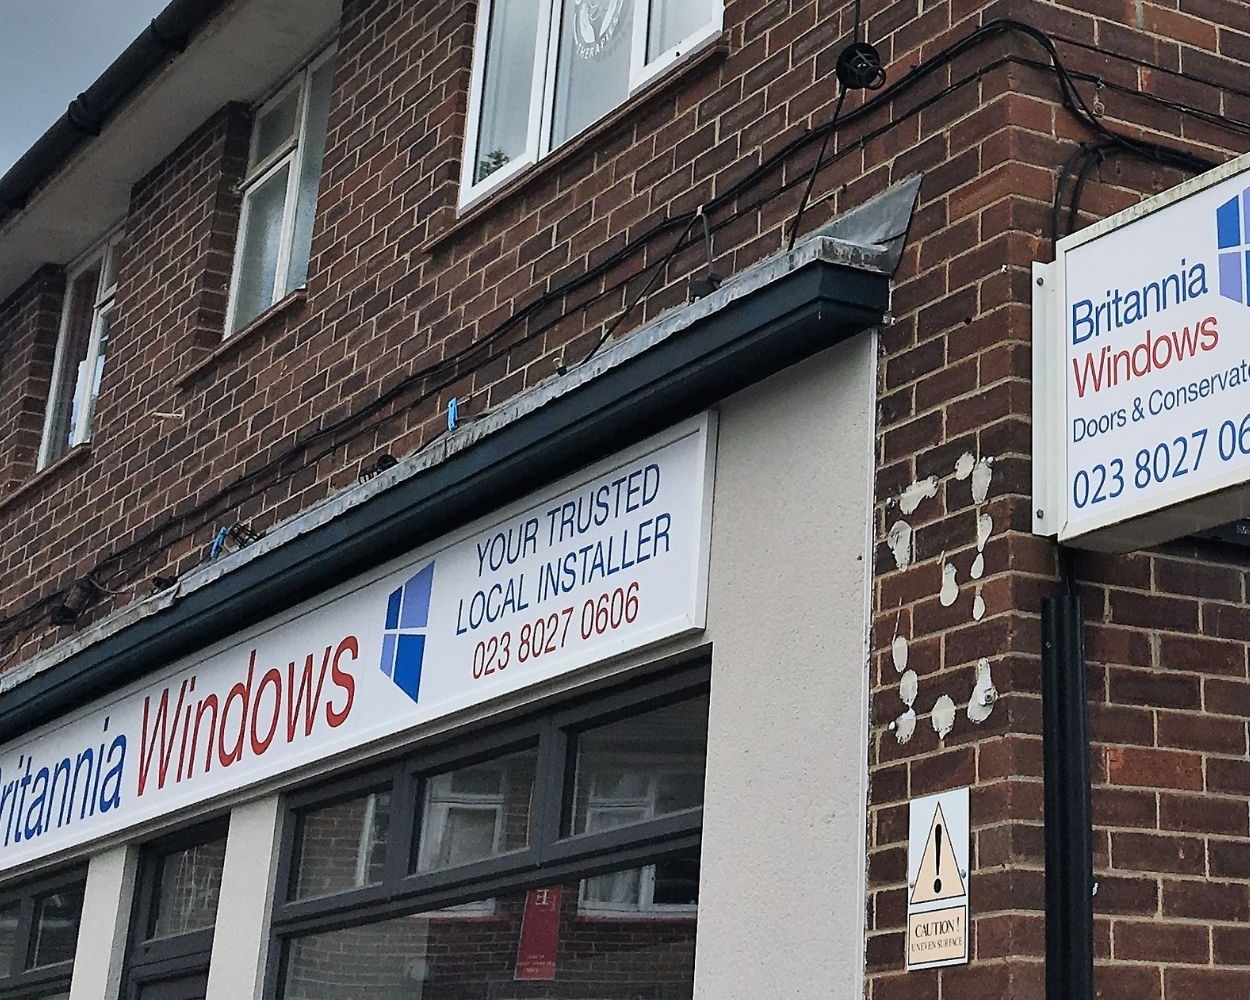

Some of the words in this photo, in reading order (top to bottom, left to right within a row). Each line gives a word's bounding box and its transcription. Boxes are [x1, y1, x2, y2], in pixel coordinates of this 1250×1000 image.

[1071, 258, 1208, 346] Britannia
[1072, 315, 1220, 399] Windows
[1073, 407, 1127, 443] Doors
[1131, 397, 1145, 421] &
[1073, 458, 1125, 509] 023
[1134, 428, 1208, 489] 8027
[476, 518, 539, 578] YOUR
[547, 463, 661, 547] TRUSTED
[456, 573, 529, 636] LOCAL
[537, 512, 671, 604] INSTALLER
[473, 631, 511, 680] 023
[518, 606, 575, 664] 8027
[581, 581, 639, 641] 0606
[0, 716, 127, 847] ritannia
[136, 635, 359, 798] Windows
